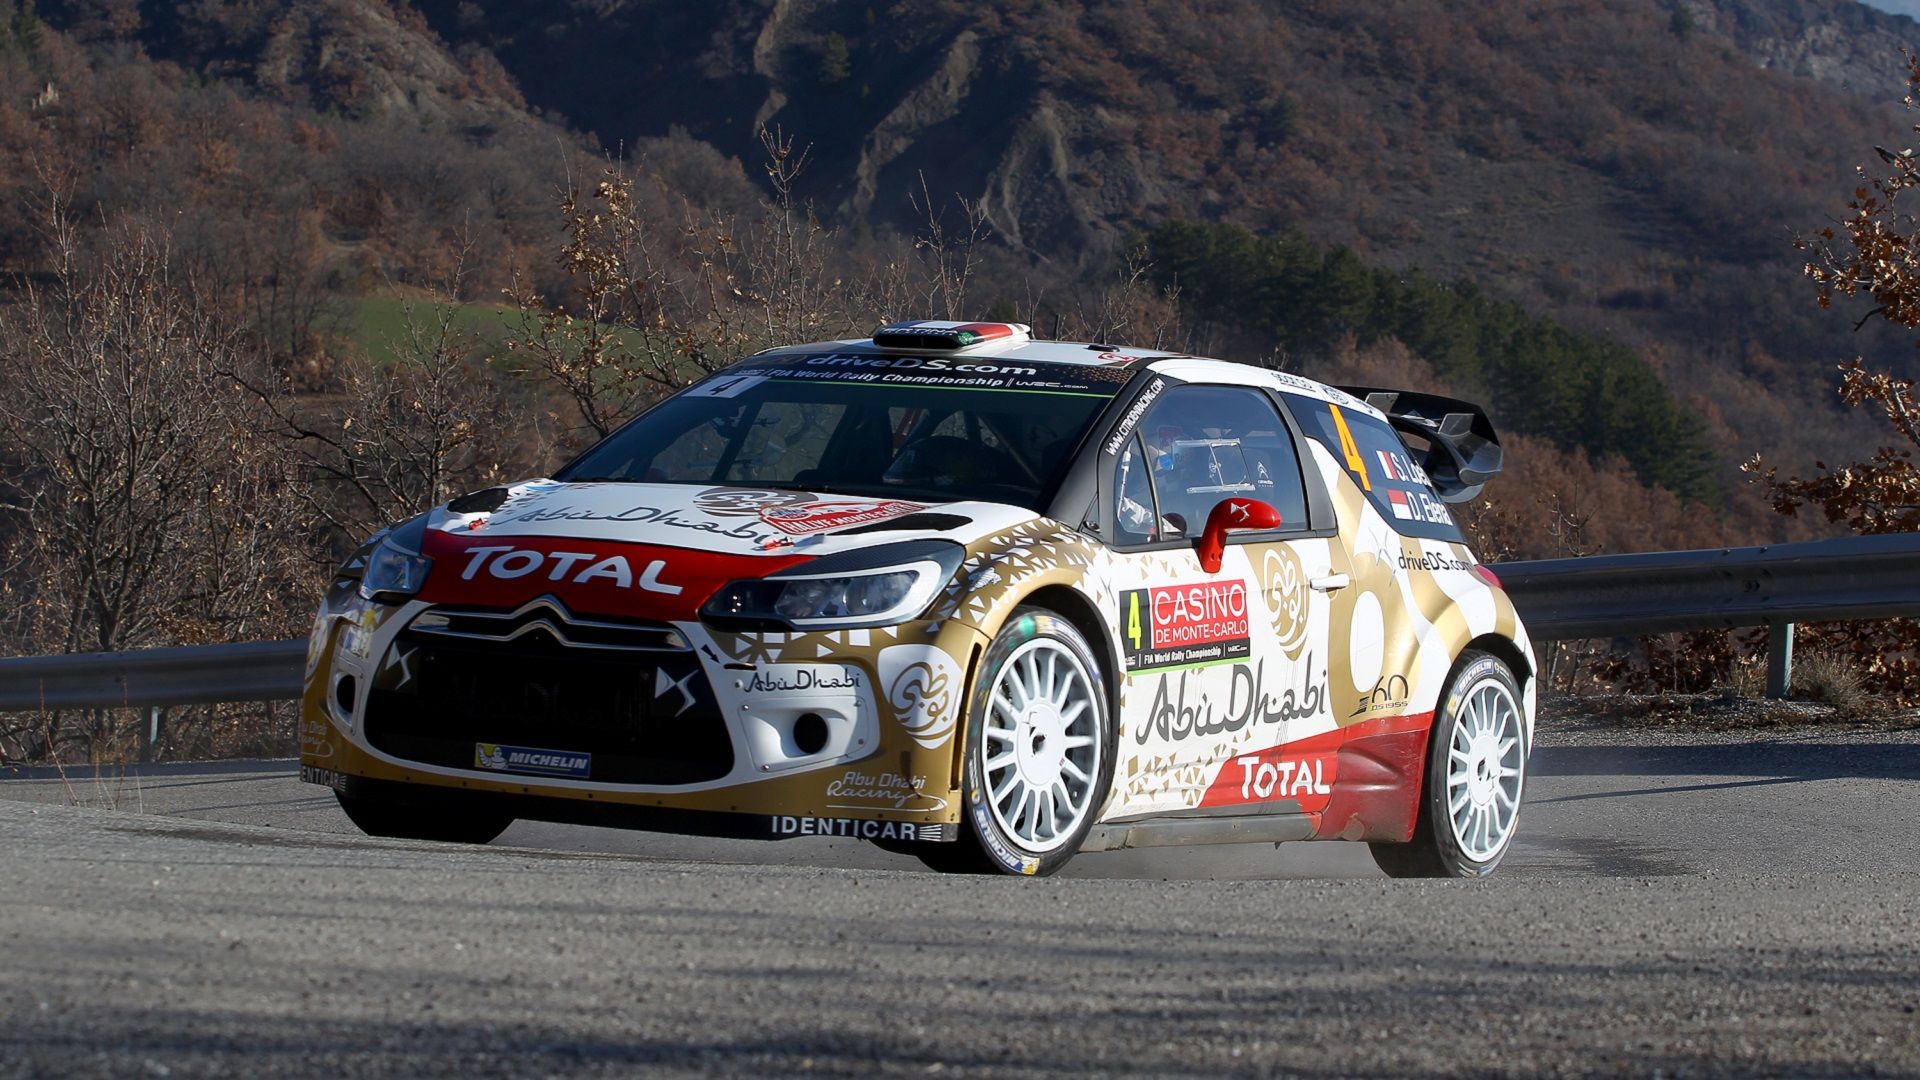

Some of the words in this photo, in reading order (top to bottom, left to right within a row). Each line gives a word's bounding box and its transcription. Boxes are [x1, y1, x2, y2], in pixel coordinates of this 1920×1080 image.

[807, 354, 1036, 376] driveDS.com
[709, 376, 747, 396] 4
[794, 370, 839, 379] World
[839, 372, 879, 382] Rally
[882, 373, 1003, 387] Championship
[1328, 404, 1372, 492] 4
[1390, 452, 1410, 482] S.
[490, 506, 606, 526] Abu
[1406, 491, 1426, 522] D.
[778, 517, 835, 533] RALLYE
[461, 545, 684, 596] TOTAL
[1398, 548, 1474, 571] driveDS.com
[1154, 583, 1247, 626] CASINO
[1128, 591, 1143, 650] 4
[1155, 627, 1171, 644] DE
[1172, 619, 1248, 642] MONTE-CARLO
[1143, 653, 1154, 665] FIA
[1154, 652, 1171, 664] World
[1171, 650, 1185, 662] Rally
[1185, 646, 1222, 660] Championship
[743, 671, 797, 693] Abu
[797, 668, 861, 690] Dhabi
[1371, 674, 1409, 704] 60
[1135, 669, 1223, 746] Abu
[1221, 650, 1328, 733] Dhabi
[508, 752, 588, 769] MICHELIN
[843, 771, 875, 786] Abu
[879, 772, 927, 789] Dhabi
[1237, 756, 1331, 799] TOTAL
[826, 780, 909, 809] Racing
[771, 815, 916, 840] IDENTICAR
